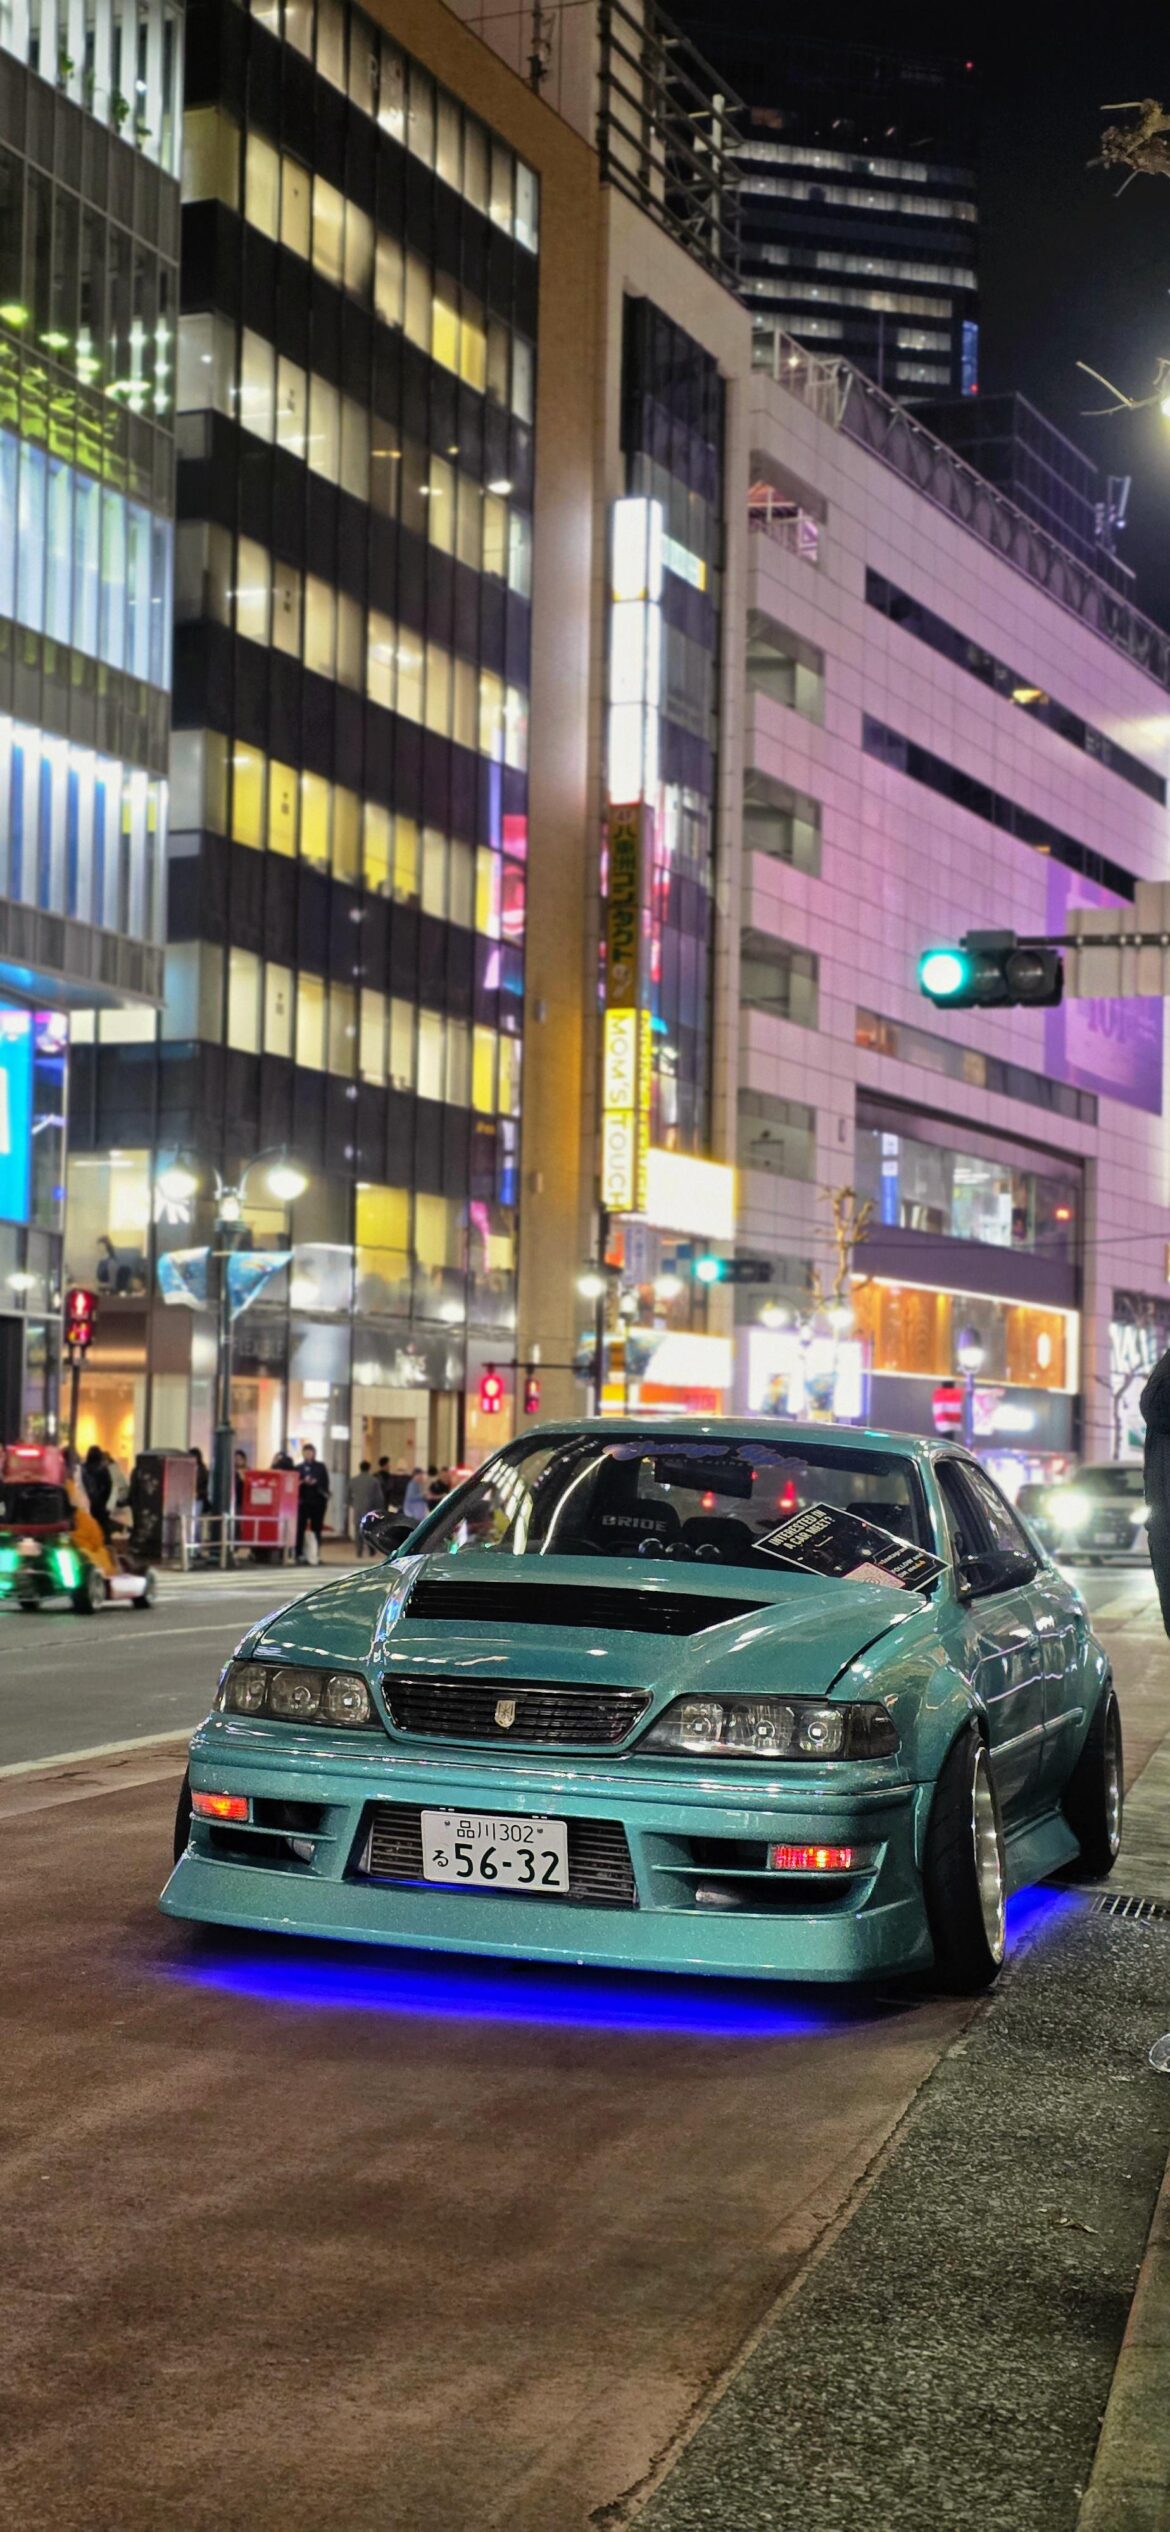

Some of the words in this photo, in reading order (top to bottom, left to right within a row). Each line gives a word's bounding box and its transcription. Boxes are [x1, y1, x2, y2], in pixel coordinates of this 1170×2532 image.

[609, 1014, 628, 1104] MOM'S
[607, 1112, 627, 1211] TOUCH
[602, 1515, 667, 1533] BRIDE
[768, 1514, 817, 1546] INTERESTED
[810, 1509, 827, 1519] IN
[789, 1531, 813, 1545] CAR
[804, 1516, 836, 1535] MEET?
[783, 1542, 797, 1550] A
[431, 1849, 449, 1868] る
[454, 1842, 561, 1886] 56-32
